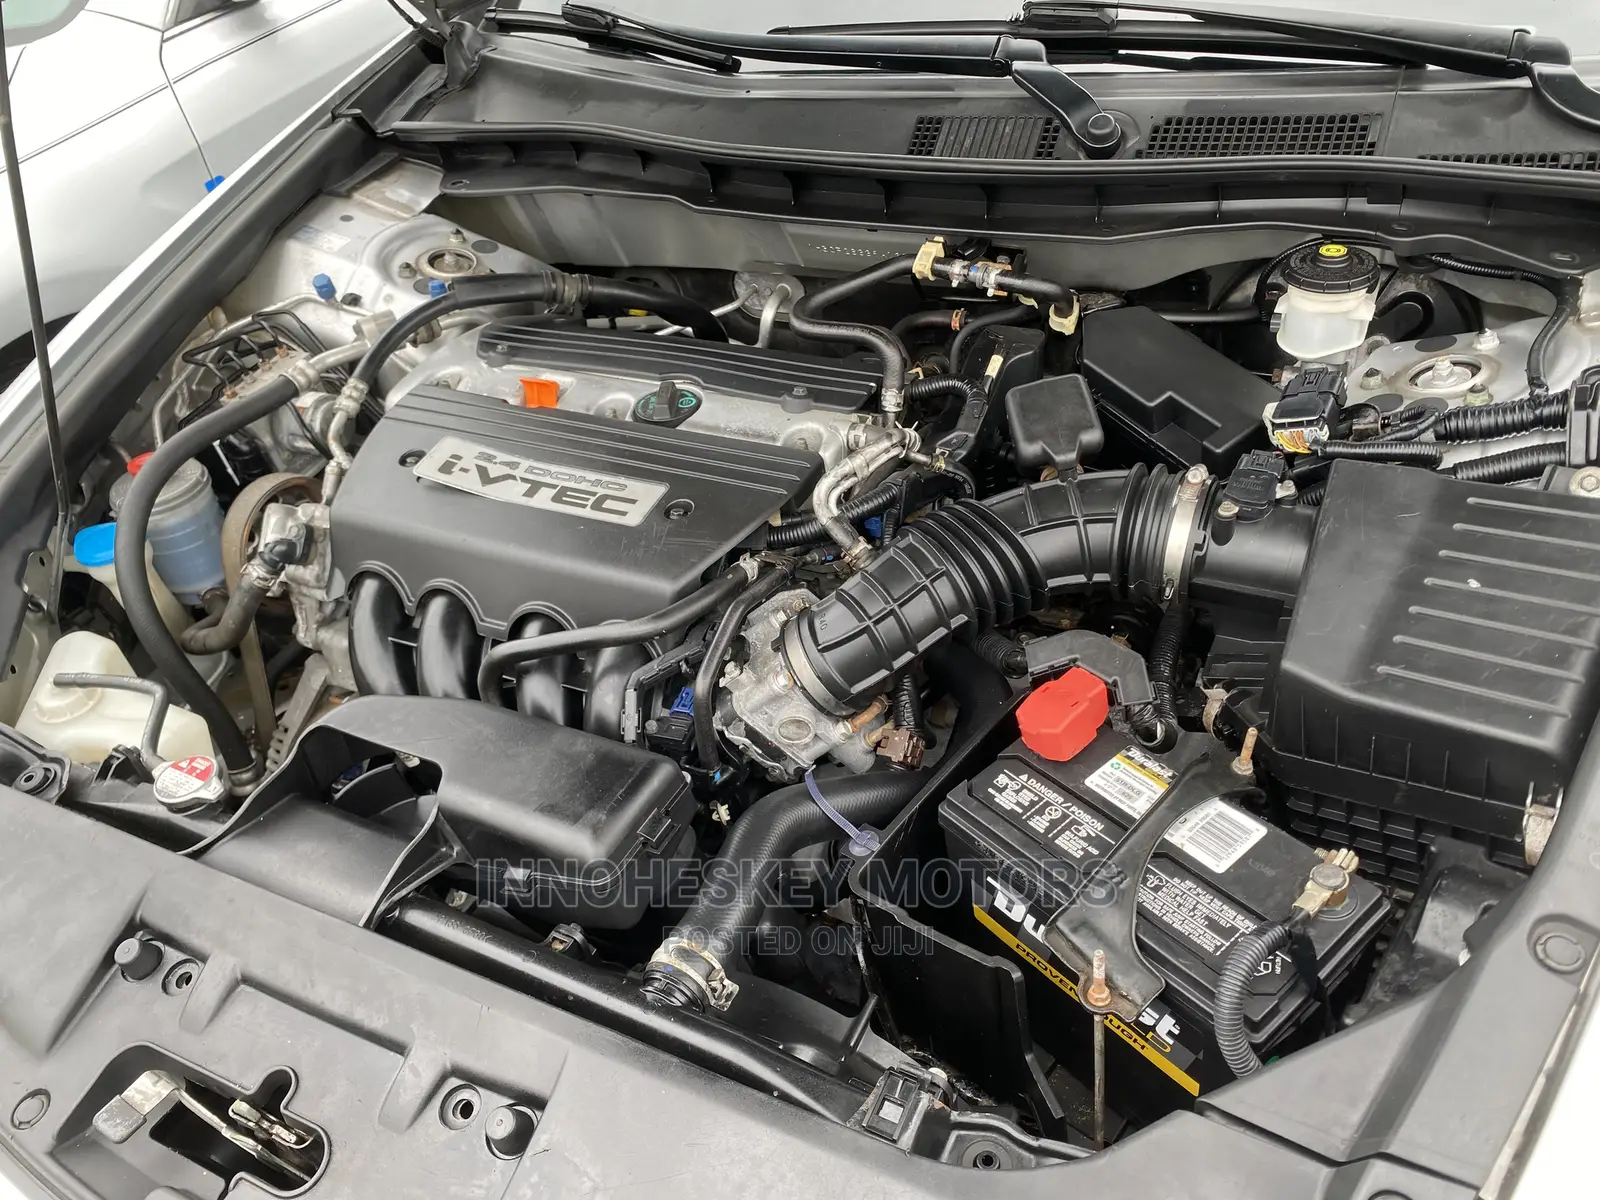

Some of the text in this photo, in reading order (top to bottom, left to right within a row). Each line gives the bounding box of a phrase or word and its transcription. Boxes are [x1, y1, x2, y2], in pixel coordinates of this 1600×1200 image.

[437, 454, 638, 516] i-VTEC
[474, 452, 627, 492] 2.4 DOHC
[1127, 747, 1174, 779] Duralast
[1027, 779, 1064, 804] DANGER
[1068, 805, 1105, 831] POISON
[1157, 890, 1208, 926] MEDICAL HELP FAST
[1161, 886, 1176, 898] WITH
[1194, 909, 1206, 918] GET
[1164, 883, 1231, 927] FLUSH EYES IMMEDIATELY
